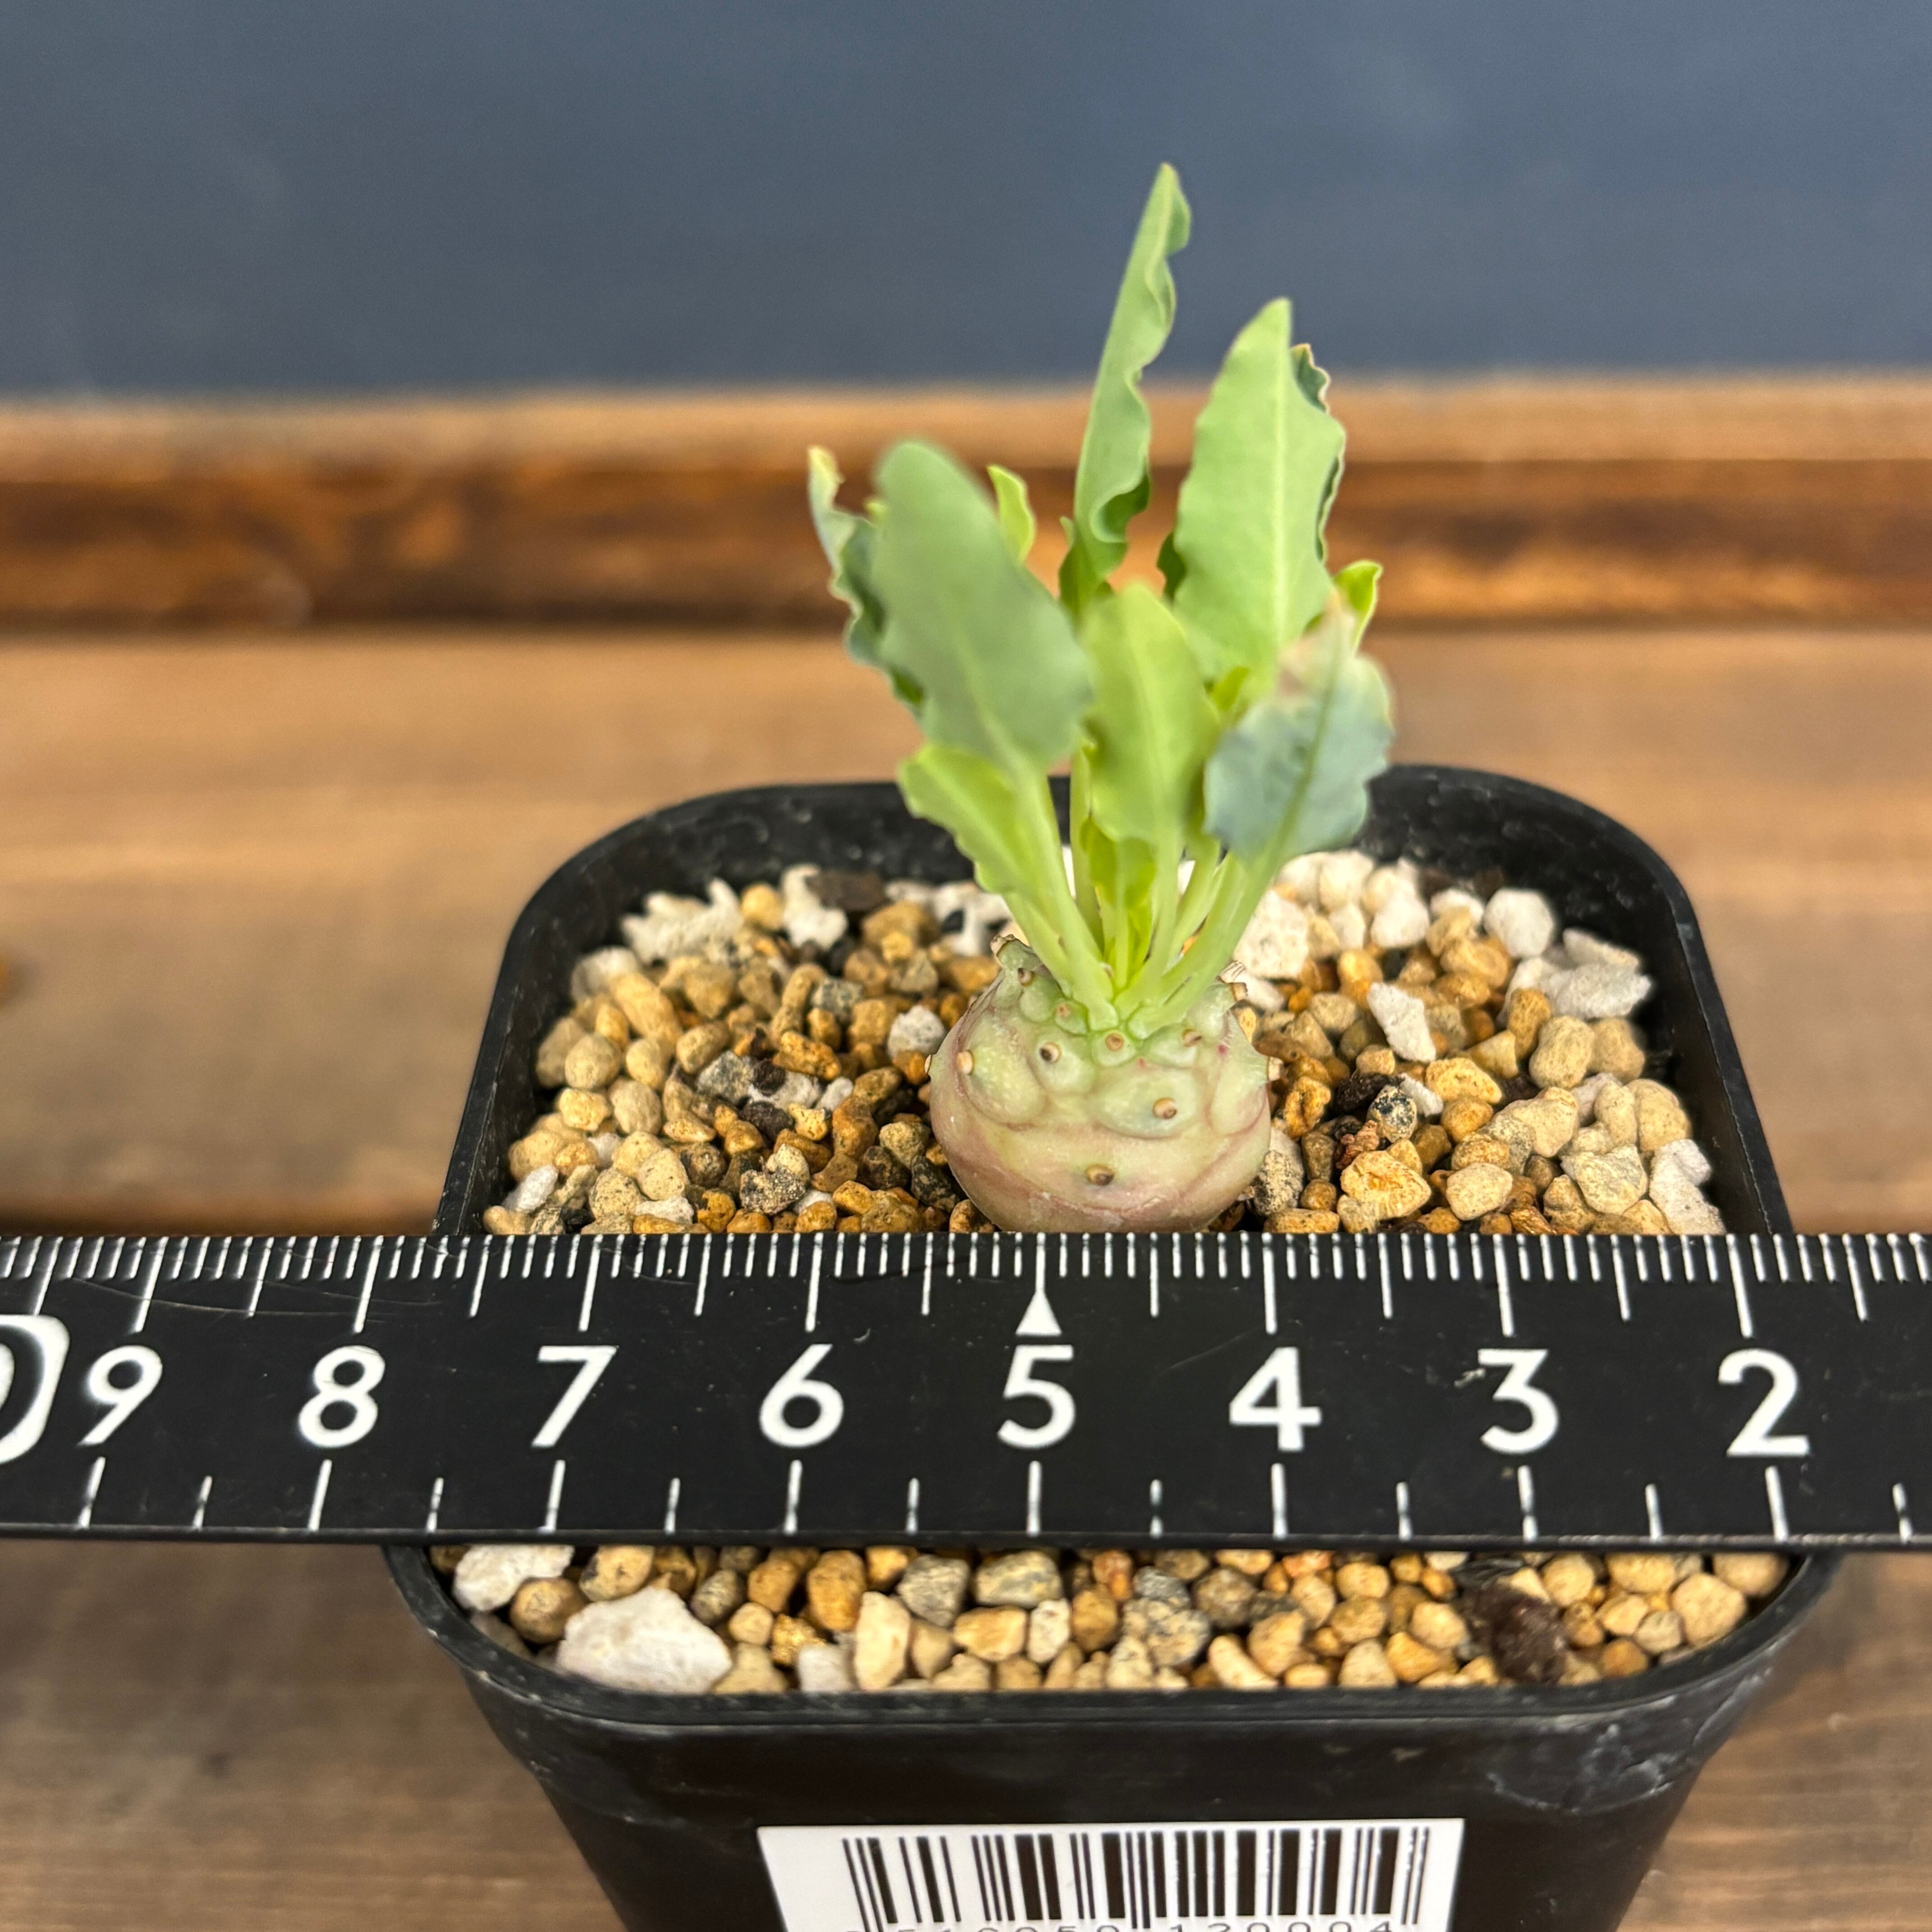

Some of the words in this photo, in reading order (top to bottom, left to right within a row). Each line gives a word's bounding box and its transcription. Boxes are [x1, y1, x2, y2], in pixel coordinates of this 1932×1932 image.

[80, 1345, 163, 1445] 9
[298, 1345, 386, 1448] 8
[532, 1345, 617, 1447] 7
[759, 1343, 844, 1447] 6
[998, 1344, 1075, 1448] 5
[1229, 1347, 1322, 1452] 4
[1477, 1348, 1559, 1454] 3
[1718, 1348, 1810, 1456] 2
